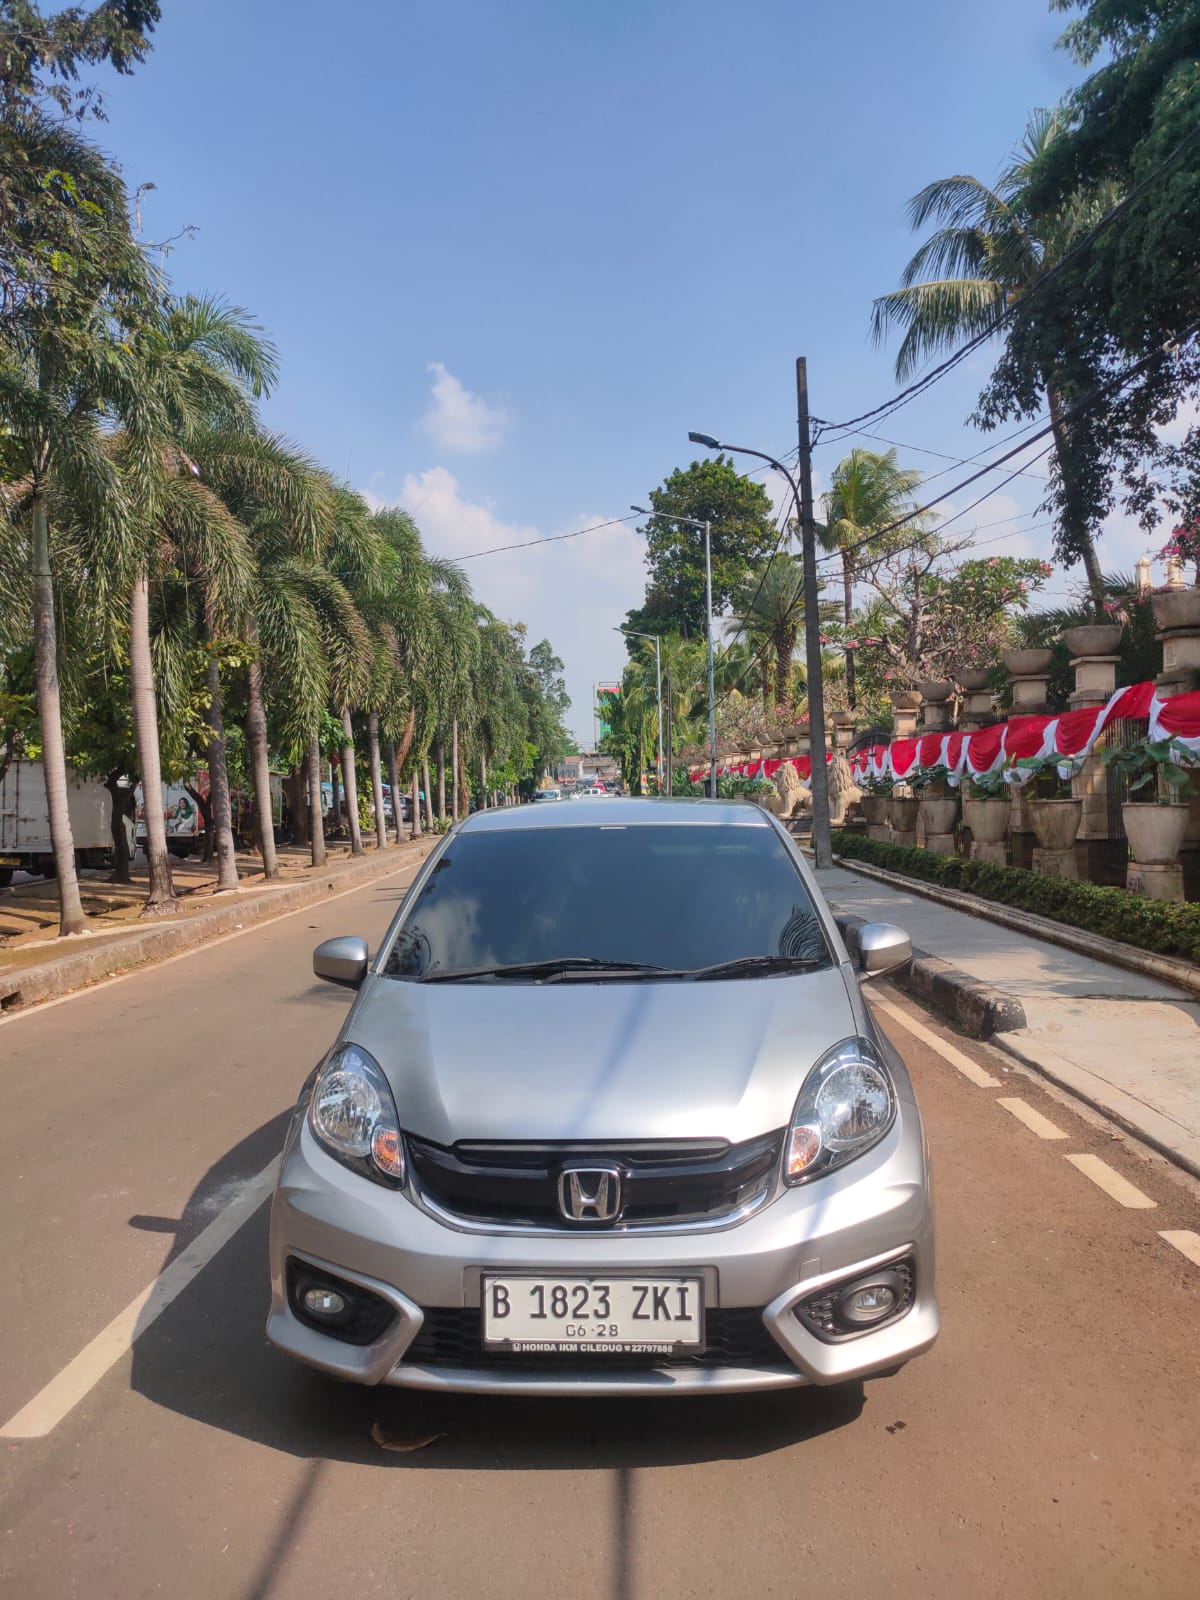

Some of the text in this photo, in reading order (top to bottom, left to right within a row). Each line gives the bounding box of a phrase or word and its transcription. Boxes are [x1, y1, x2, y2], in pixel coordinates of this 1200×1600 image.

[492, 1285, 692, 1320] B 1823 ZKI
[522, 1343, 557, 1352] HONDA
[560, 1343, 578, 1352] IKM
[580, 1343, 623, 1352] CILEDUG
